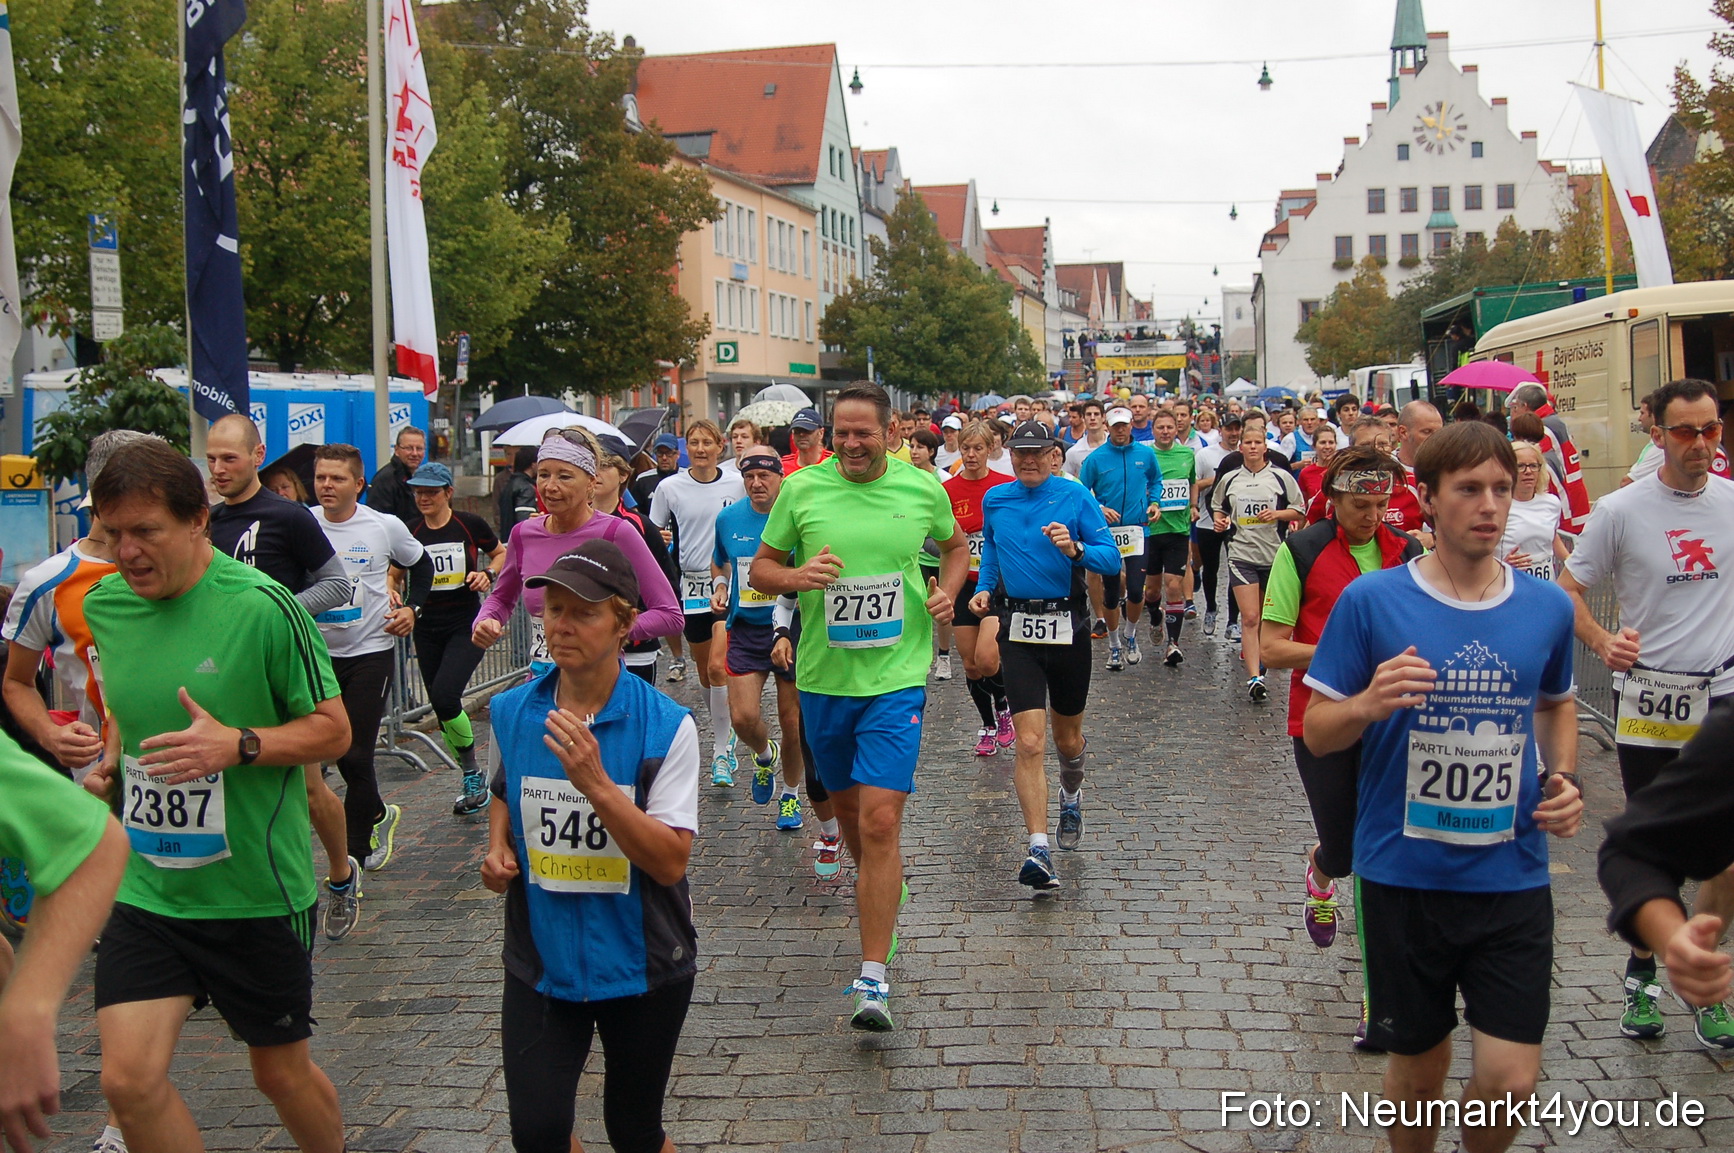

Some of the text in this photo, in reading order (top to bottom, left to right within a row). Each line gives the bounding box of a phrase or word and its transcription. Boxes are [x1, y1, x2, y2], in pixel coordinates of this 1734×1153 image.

[719, 343, 735, 361] D
[1553, 340, 1604, 367] Bayerisches
[1125, 359, 1155, 367] START
[1553, 370, 1577, 389] Rotes
[192, 380, 240, 415] mobile.
[1553, 393, 1576, 412] Kreuz
[1160, 486, 1187, 499] 2872
[1115, 533, 1130, 547] 08
[434, 554, 454, 573] 01
[826, 581, 890, 592] PARTL Neumarkt
[1666, 570, 1719, 585] gotcha
[687, 580, 714, 598] 271
[833, 591, 897, 622] 2737
[324, 612, 346, 622] Claus
[856, 628, 879, 639] Uwe
[1022, 617, 1058, 640] 551
[1627, 674, 1695, 691] PARTL Neumarkt
[1430, 694, 1492, 705] Neumarkter
[1638, 689, 1692, 721] 546
[1449, 706, 1516, 716] 16.September 2012
[1625, 718, 1669, 738] Patrick
[1412, 741, 1508, 757] PARTL Neumarkt
[126, 765, 147, 782] PARTL
[1419, 760, 1513, 802] 2025
[523, 787, 591, 805] PARTL Neum
[130, 784, 212, 828] 2387
[540, 806, 608, 851] 548
[1437, 811, 1494, 829] Manuel
[157, 837, 182, 854] Jan
[540, 855, 608, 881] Christa
